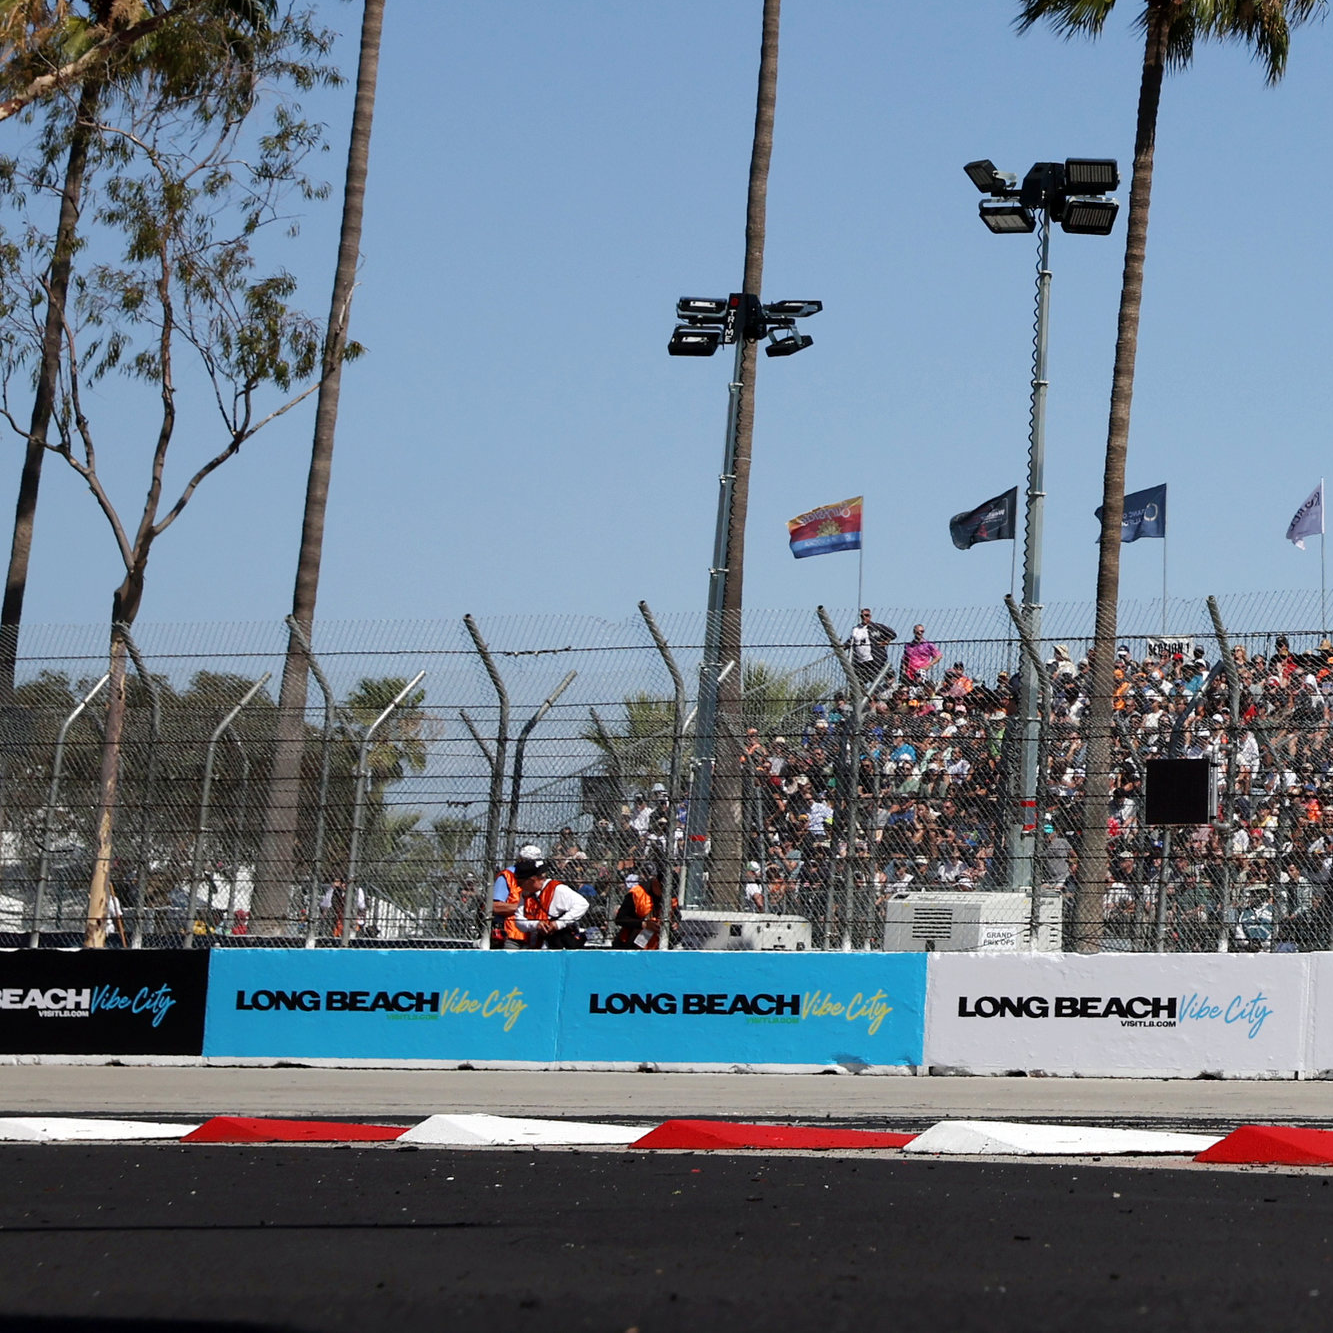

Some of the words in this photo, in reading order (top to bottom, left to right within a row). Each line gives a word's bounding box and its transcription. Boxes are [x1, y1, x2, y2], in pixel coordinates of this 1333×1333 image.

[725, 309, 736, 343] TRIME
[986, 931, 1013, 939] GRAND
[0, 988, 91, 1010] EACH
[91, 984, 131, 1014] Vibe
[132, 983, 176, 1028] City
[38, 1010, 90, 1018] VISITLB.COM
[236, 990, 320, 1011] LONG
[325, 991, 439, 1012] BEACH
[440, 987, 481, 1016] Vibe
[482, 986, 528, 1032] City
[589, 993, 677, 1014] LONG
[682, 994, 800, 1016] BEACH
[801, 990, 845, 1020] Vibe
[846, 989, 894, 1035] City
[958, 996, 1049, 1018] LONG
[1054, 997, 1177, 1019] BEACH
[1178, 993, 1223, 1023] Vibe
[1224, 992, 1274, 1039] City
